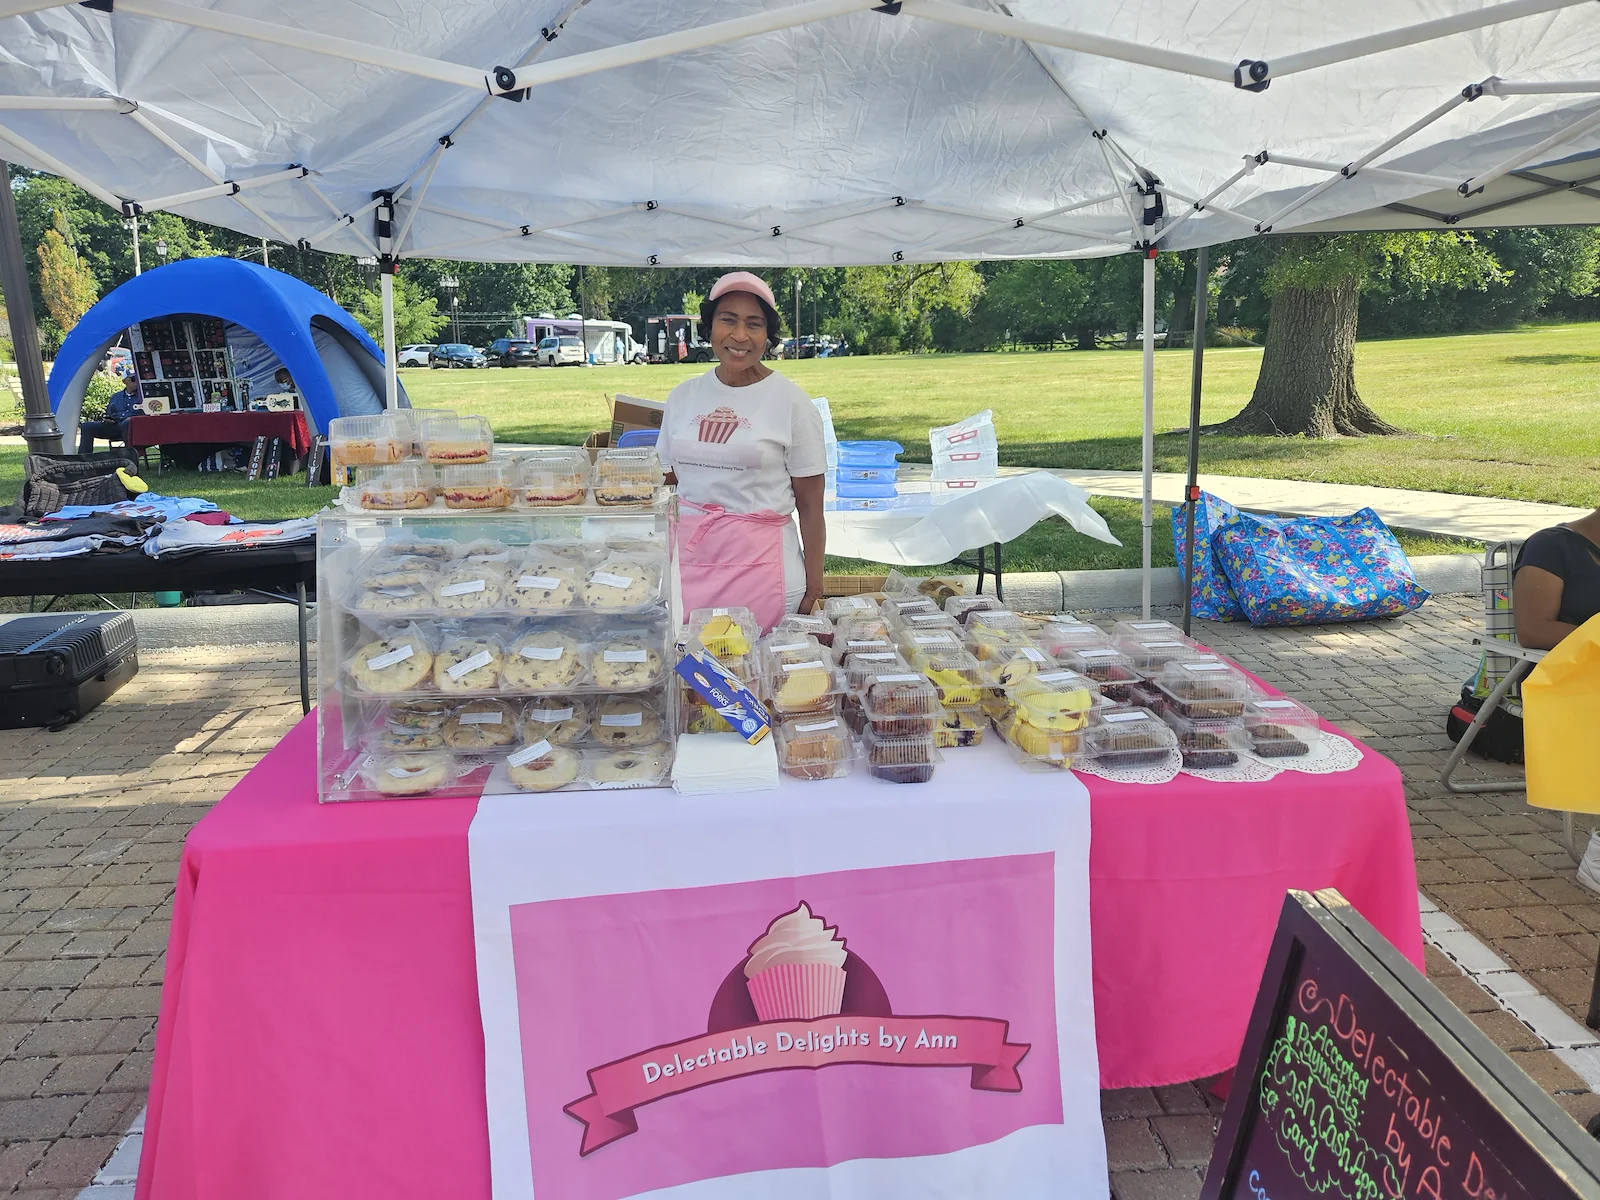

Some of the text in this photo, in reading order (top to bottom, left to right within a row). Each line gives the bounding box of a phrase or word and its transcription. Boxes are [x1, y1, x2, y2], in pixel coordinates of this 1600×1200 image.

[709, 688, 730, 708] FORKS
[641, 1025, 958, 1084] Delectable Delights by Ann
[1311, 1024, 1369, 1101] Accepted
[1331, 993, 1451, 1167] Delectable
[1280, 1106, 1319, 1173] Card
[1318, 1104, 1351, 1173] Cash
[1383, 1112, 1412, 1199] by
